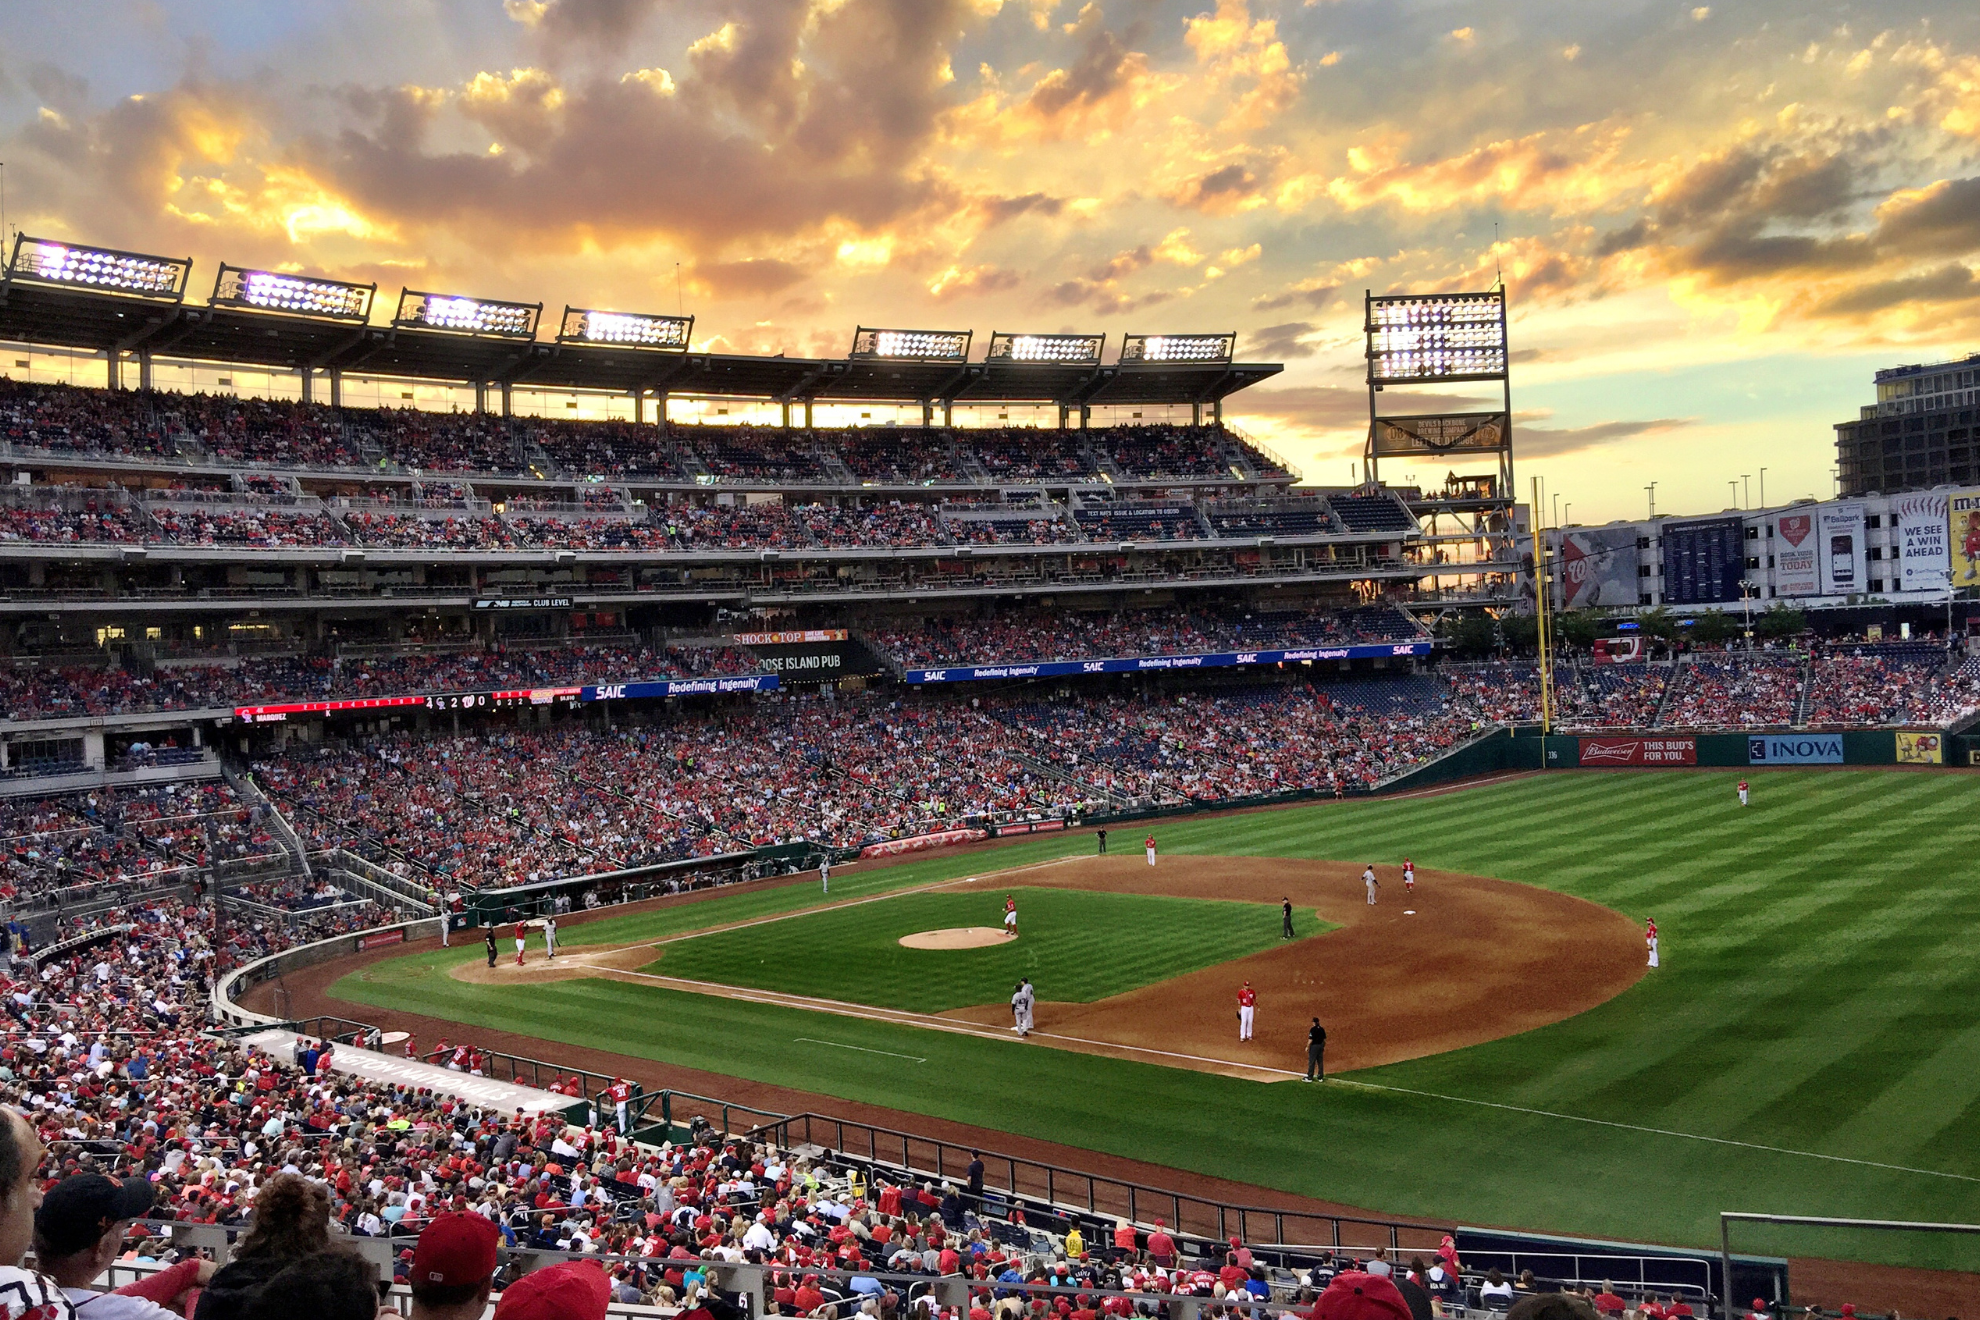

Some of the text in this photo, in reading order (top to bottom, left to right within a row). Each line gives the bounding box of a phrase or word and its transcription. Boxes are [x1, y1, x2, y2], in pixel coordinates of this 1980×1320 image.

[1442, 426, 1467, 434] COMPANY
[1831, 515, 1860, 523] Ballpark
[1904, 525, 1942, 536] WE SEE
[1907, 536, 1941, 546] A WIN
[1906, 547, 1943, 557] AHEAD
[1780, 560, 1813, 570] TODAY
[533, 599, 550, 607] CLUB
[733, 632, 801, 645] SHOCK TOP
[1284, 649, 1349, 660] Redefining Ingenuity
[1393, 645, 1414, 655] SAIC
[759, 655, 841, 671] OOSE ISLAND PUB
[1139, 657, 1203, 668] Redefining Ingenuity
[1236, 653, 1257, 664] SAIC
[974, 665, 1039, 678] Redefining Ingenuity
[1083, 662, 1104, 672] SAIC
[924, 671, 946, 681] SAIC
[668, 678, 761, 693] Redefining Ingenuity
[596, 685, 626, 700] SAIC
[451, 698, 457, 708] 2
[478, 696, 485, 706] 0
[256, 713, 286, 722] MARQUEZ
[1643, 740, 1693, 750] THIS BUD'S
[1772, 741, 1841, 757] INOVA
[1588, 747, 1632, 756] Budweiser
[1644, 751, 1685, 761] FOR YOU.
[391, 1067, 516, 1101] NATIONALS
[616, 1088, 626, 1098] 31
